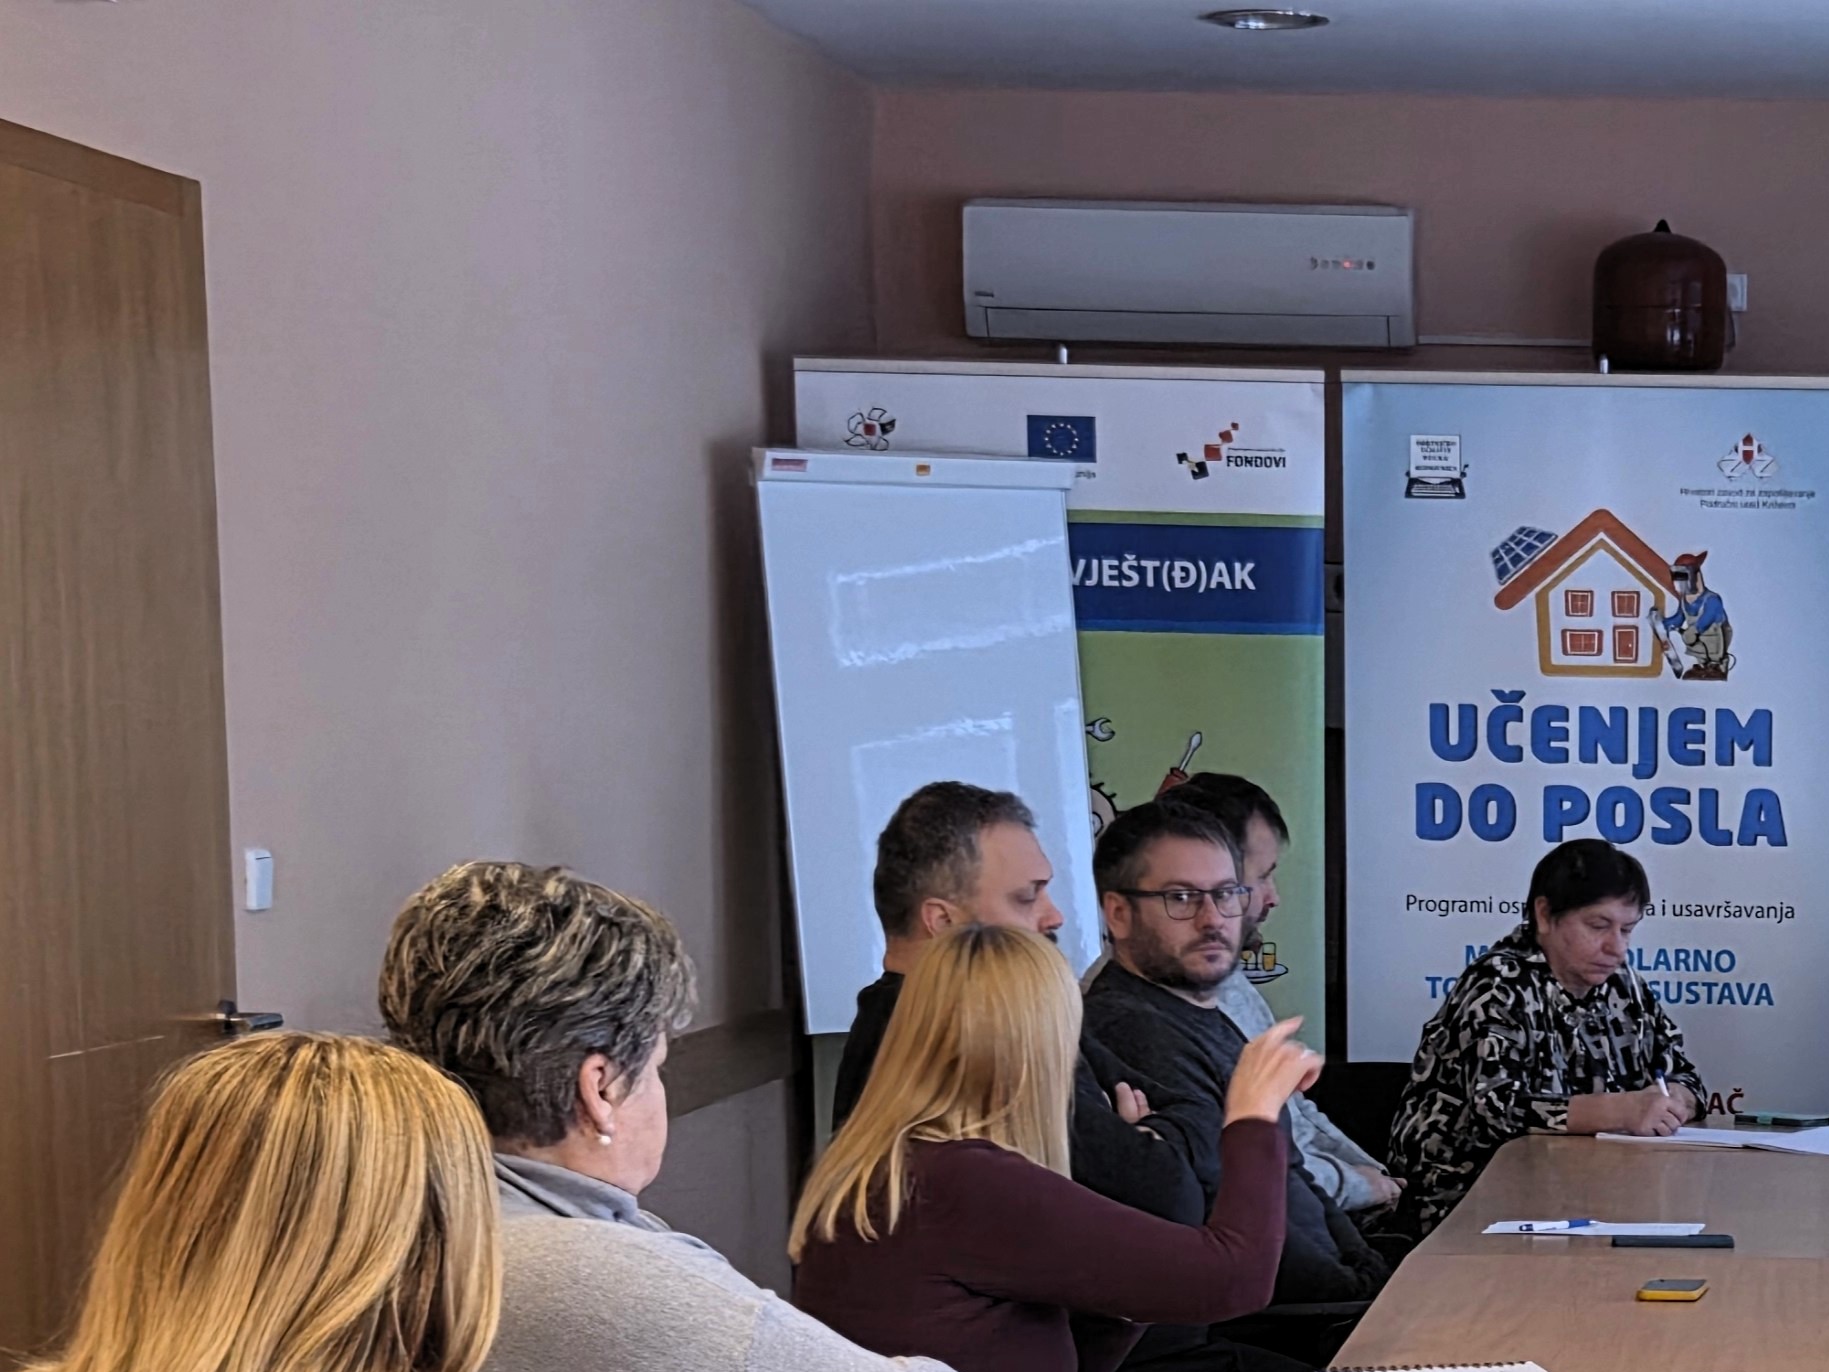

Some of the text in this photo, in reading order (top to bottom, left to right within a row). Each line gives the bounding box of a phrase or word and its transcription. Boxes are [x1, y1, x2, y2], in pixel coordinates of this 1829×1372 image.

[1226, 455, 1287, 469] FONDOVI
[1428, 689, 1774, 780] UČENJEM
[1414, 782, 1789, 848] DO POSLA
[1405, 894, 1492, 917] Programi
[1672, 901, 1796, 924] usavršavanja
[1648, 980, 1775, 1007] SUSTAVA
[1706, 1088, 1745, 1115] AČ
